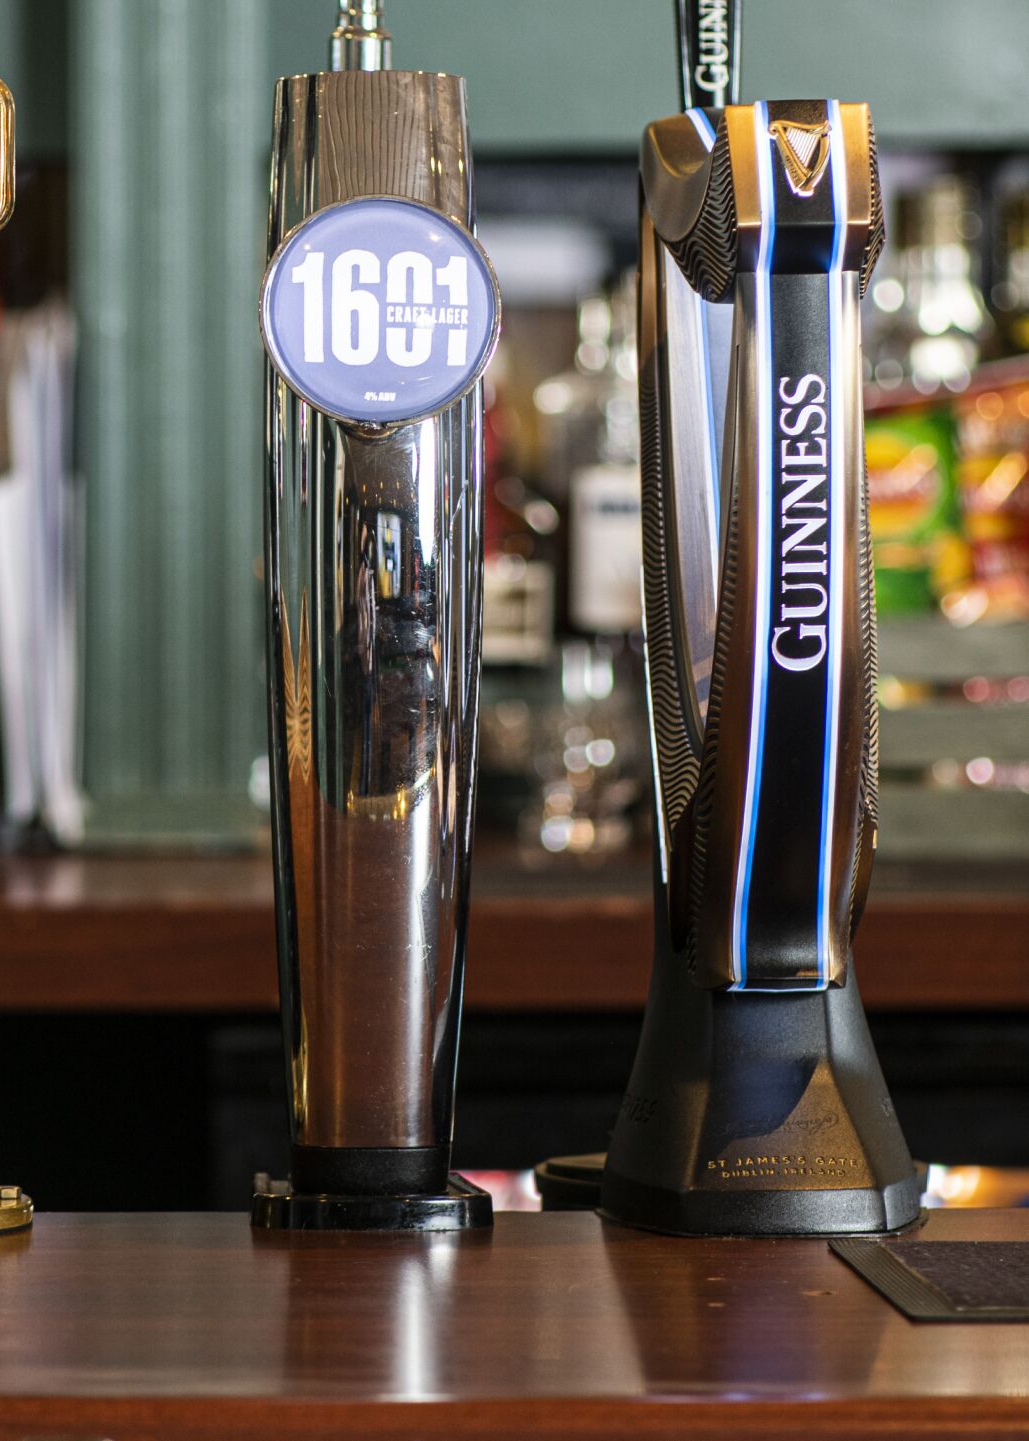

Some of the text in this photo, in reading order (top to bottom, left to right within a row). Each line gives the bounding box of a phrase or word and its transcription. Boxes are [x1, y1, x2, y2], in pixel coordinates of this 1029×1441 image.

[431, 306, 468, 325] LAGER
[771, 373, 828, 672] GUINNESS
[707, 1156, 859, 1169] ST JAMES'S GATE
